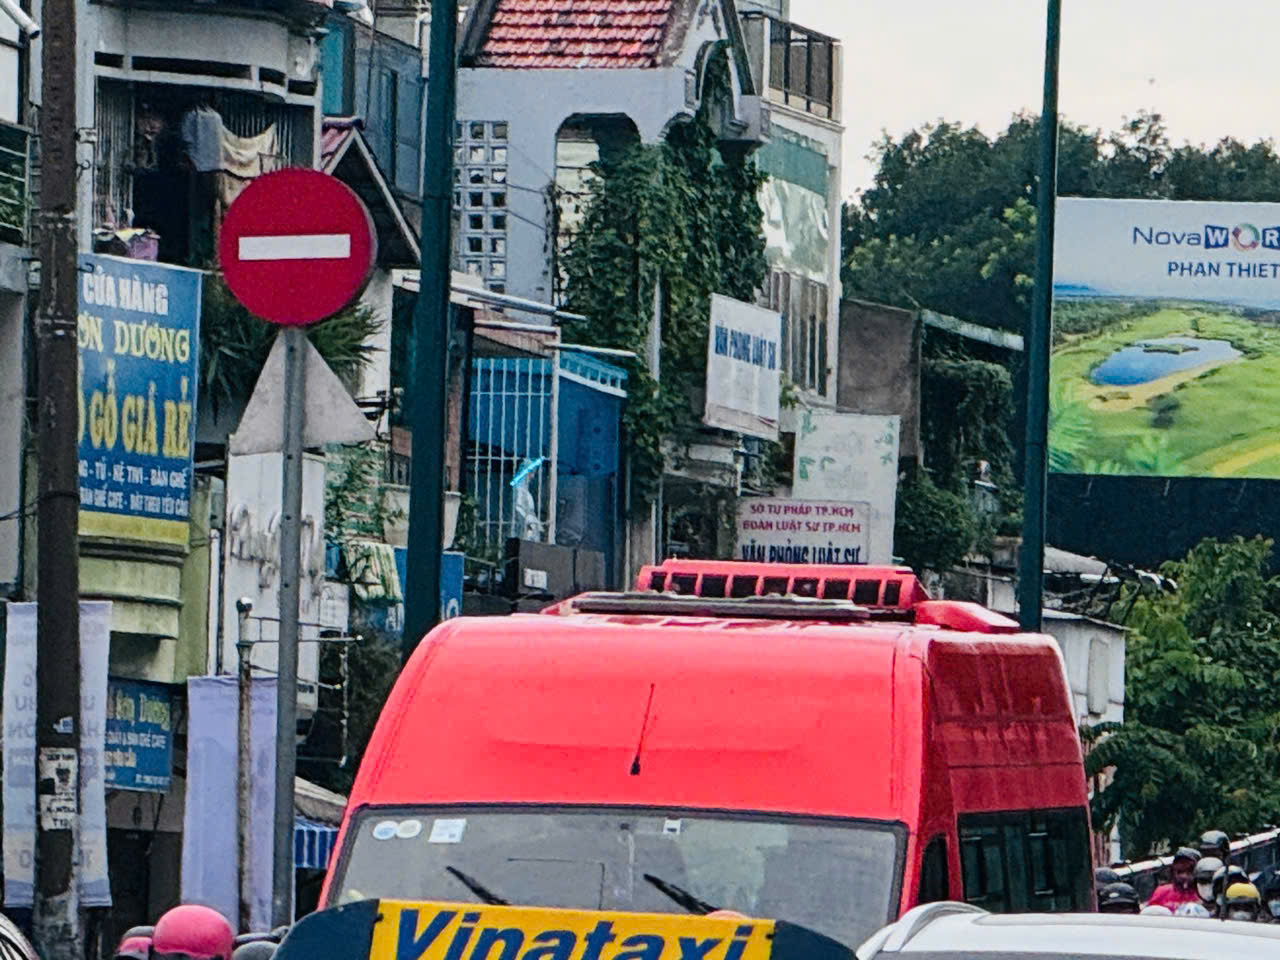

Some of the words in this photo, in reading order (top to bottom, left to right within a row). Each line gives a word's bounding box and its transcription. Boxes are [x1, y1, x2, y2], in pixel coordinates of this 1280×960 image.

[1167, 260, 1220, 278] PHAN
[118, 274, 169, 316] HÀNG
[114, 320, 191, 363] DƯƠNG
[814, 506, 855, 519] TP.HCM
[823, 522, 861, 534] TP.HCM
